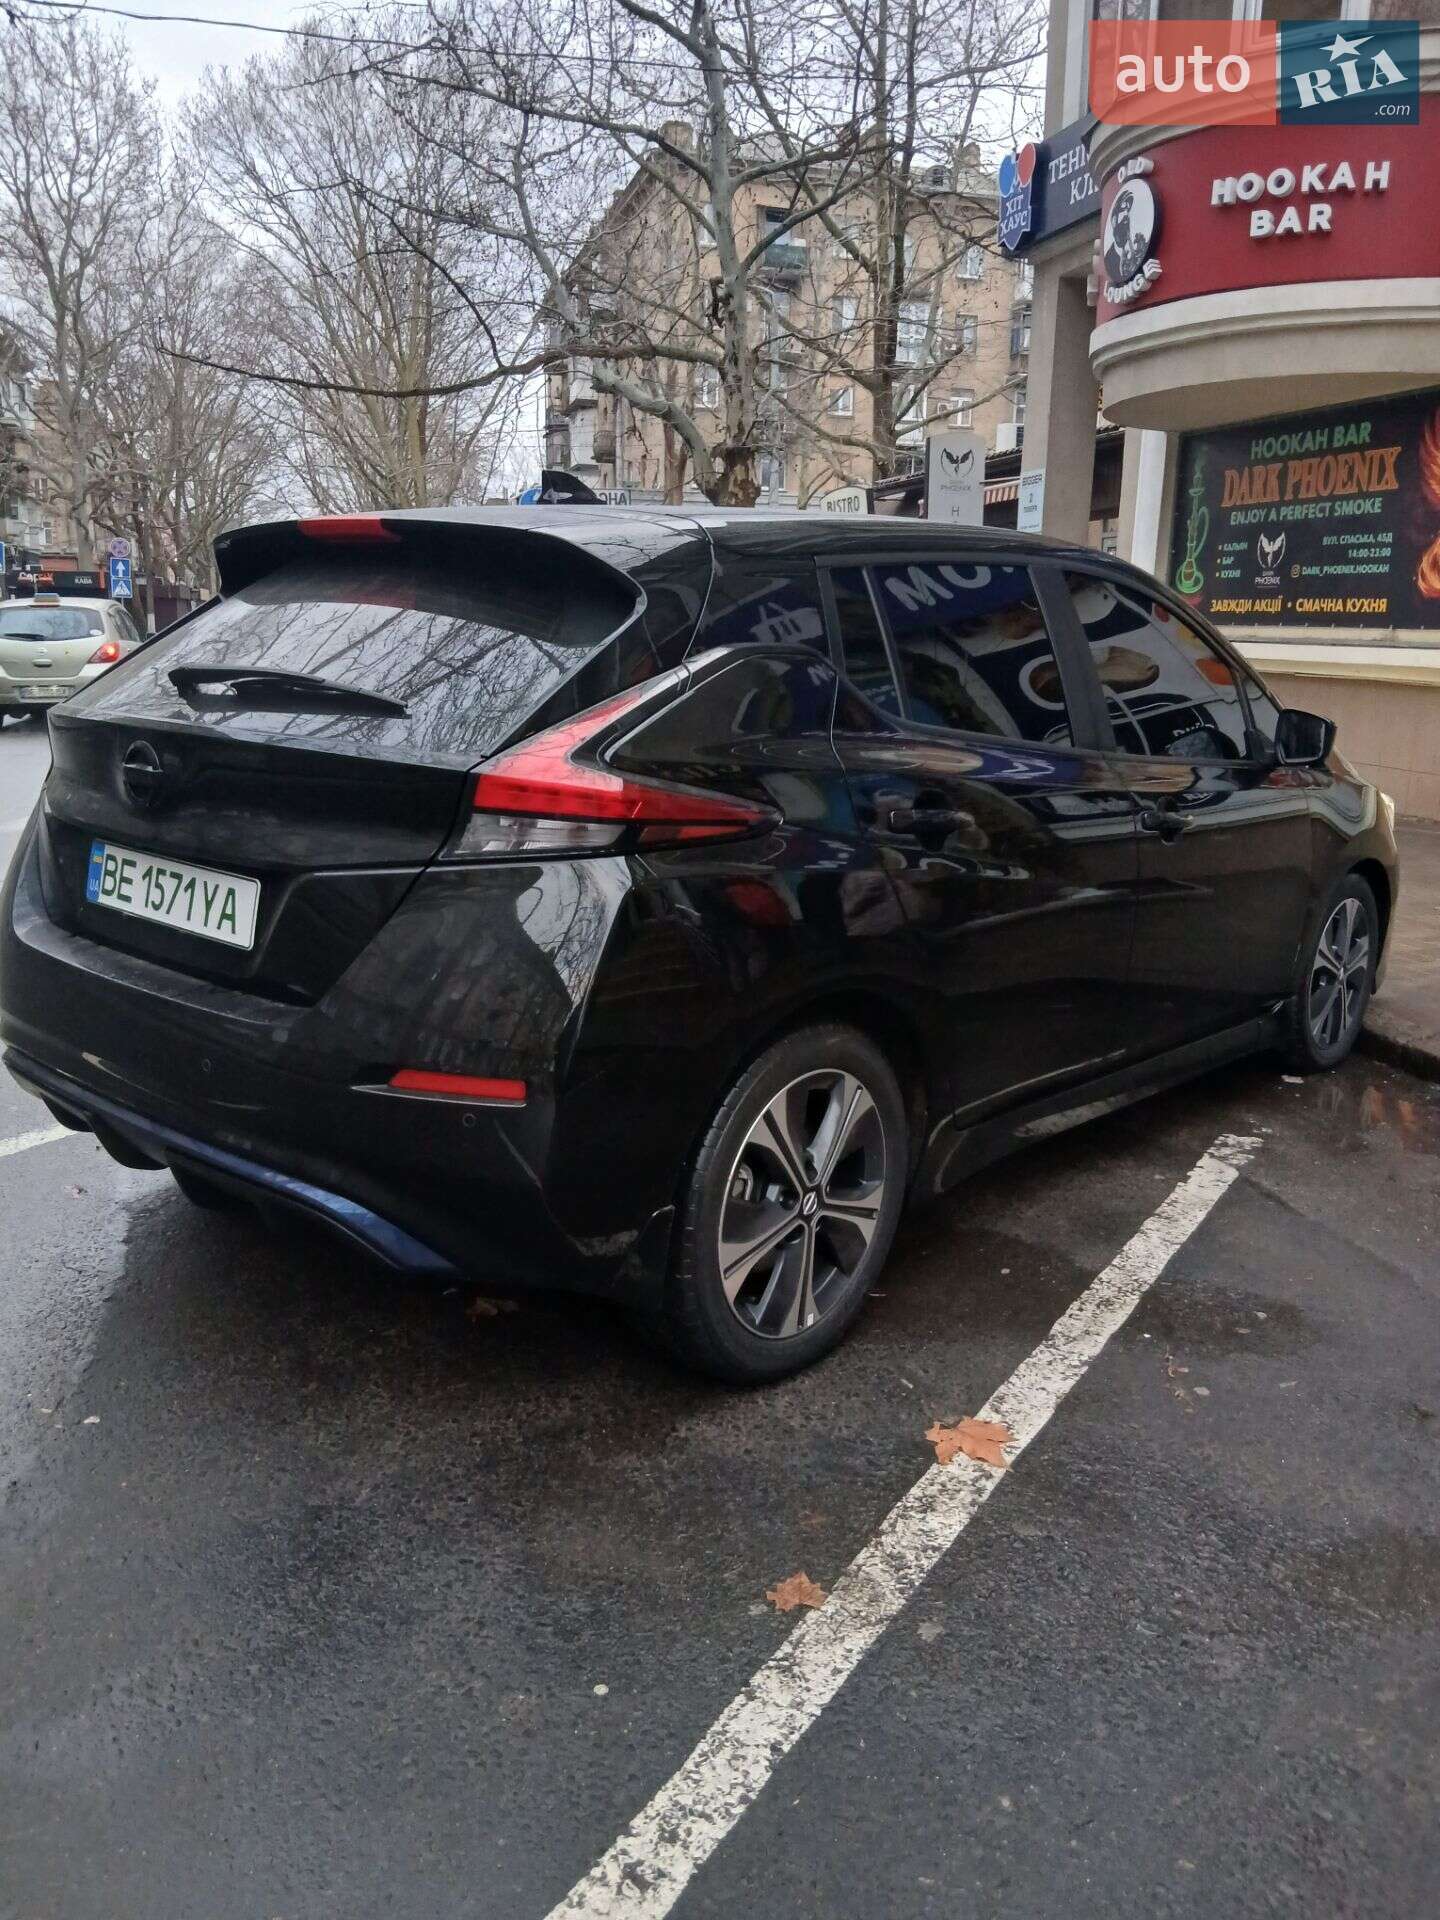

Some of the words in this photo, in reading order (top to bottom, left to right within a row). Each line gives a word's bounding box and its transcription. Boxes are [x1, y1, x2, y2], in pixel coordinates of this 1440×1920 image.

[1048, 144, 1090, 184] ТЕНІ
[1069, 172, 1099, 205] КЛ
[1211, 160, 1391, 208] HOOKAH
[1000, 210, 1028, 237] ХАУС
[1250, 203, 1335, 240] BAR
[1104, 258, 1162, 304] LOUNGE
[1251, 428, 1329, 460] HOOKAH
[1332, 421, 1372, 448] BAR
[1221, 462, 1283, 508] DARK
[1284, 446, 1402, 501] PHOENIX
[826, 495, 861, 513] BISTRO
[1230, 508, 1268, 526] ENJOY
[1268, 507, 1278, 522] A
[1279, 502, 1332, 521] PERFECT
[1334, 497, 1384, 516] SMOKE
[1210, 599, 1253, 614] ЗАВЖДИ
[1253, 595, 1283, 614] АКЦІЇ
[1295, 598, 1344, 612] СМАЧНА
[1345, 598, 1388, 613] КУХНЯ
[88, 878, 99, 891] UA
[101, 853, 137, 903] BE
[142, 865, 196, 922] 1571
[203, 880, 236, 935] YA
